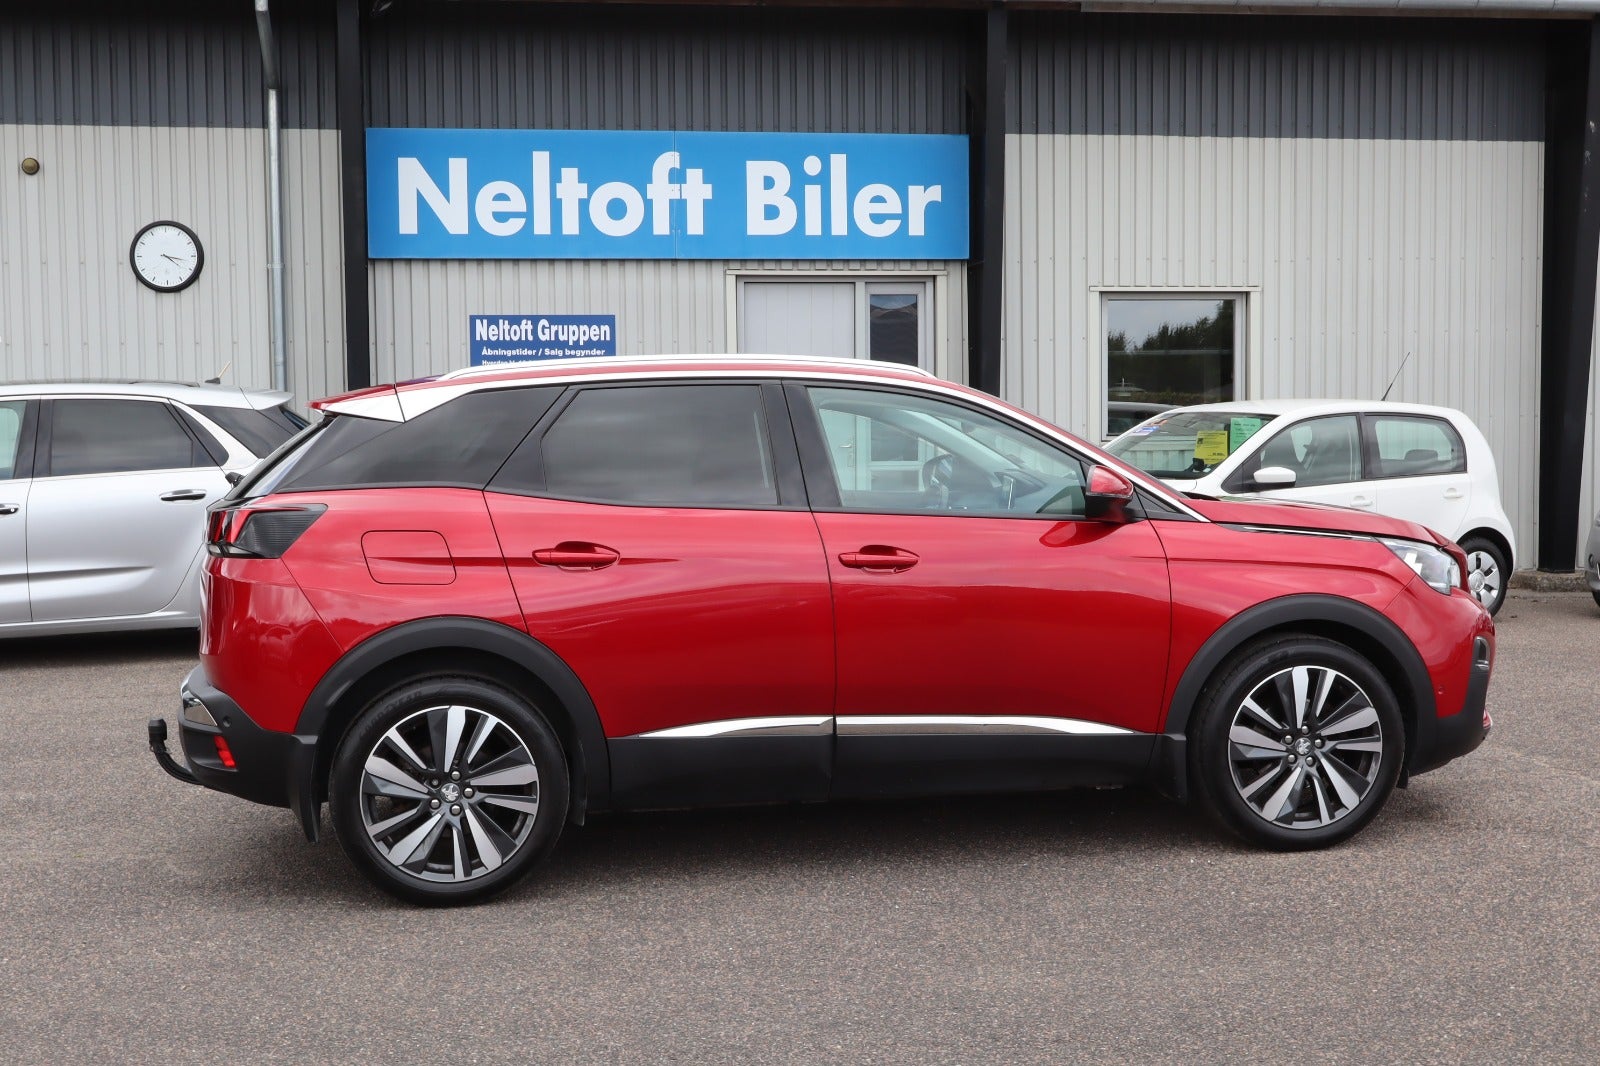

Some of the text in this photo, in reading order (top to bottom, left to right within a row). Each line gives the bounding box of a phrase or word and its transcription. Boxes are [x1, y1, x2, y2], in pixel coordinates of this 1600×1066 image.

[397, 151, 941, 238] Neltoft Biler
[475, 318, 611, 345] Neltoft Gruppen
[482, 346, 536, 356] Åbningstider
[544, 348, 563, 356] Salg
[565, 348, 606, 357] begynder
